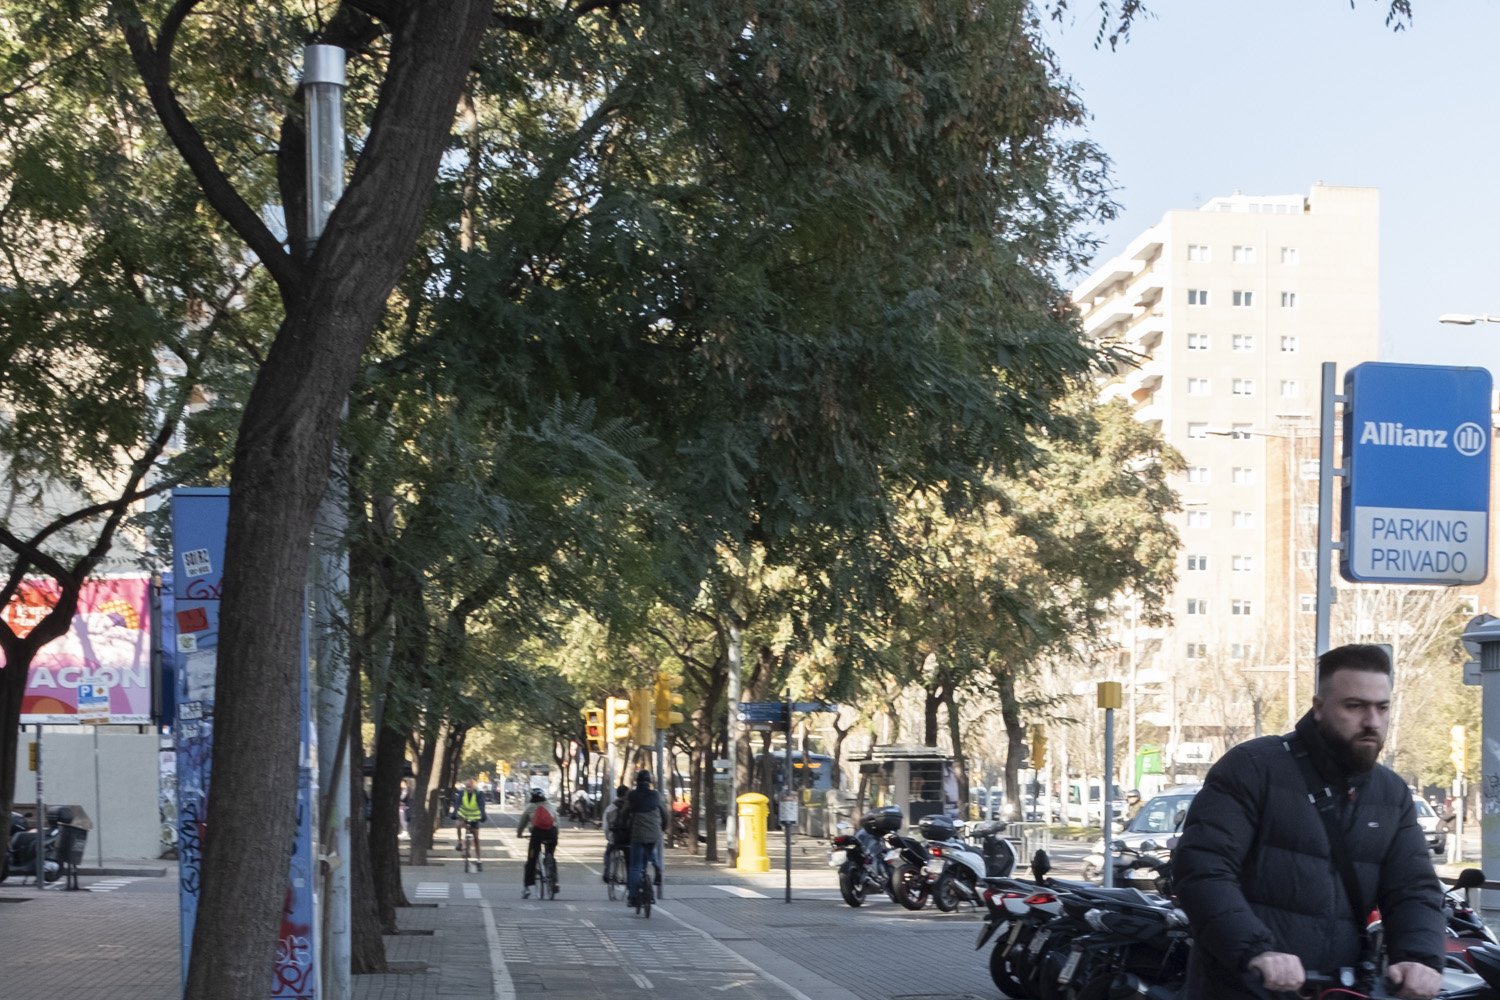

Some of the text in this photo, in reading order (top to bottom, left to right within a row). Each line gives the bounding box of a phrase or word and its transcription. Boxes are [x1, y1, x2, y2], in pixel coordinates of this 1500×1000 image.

[1360, 421, 1448, 449] Allianz
[1371, 517, 1469, 543] PARKING
[1370, 548, 1468, 574] PRIVADO
